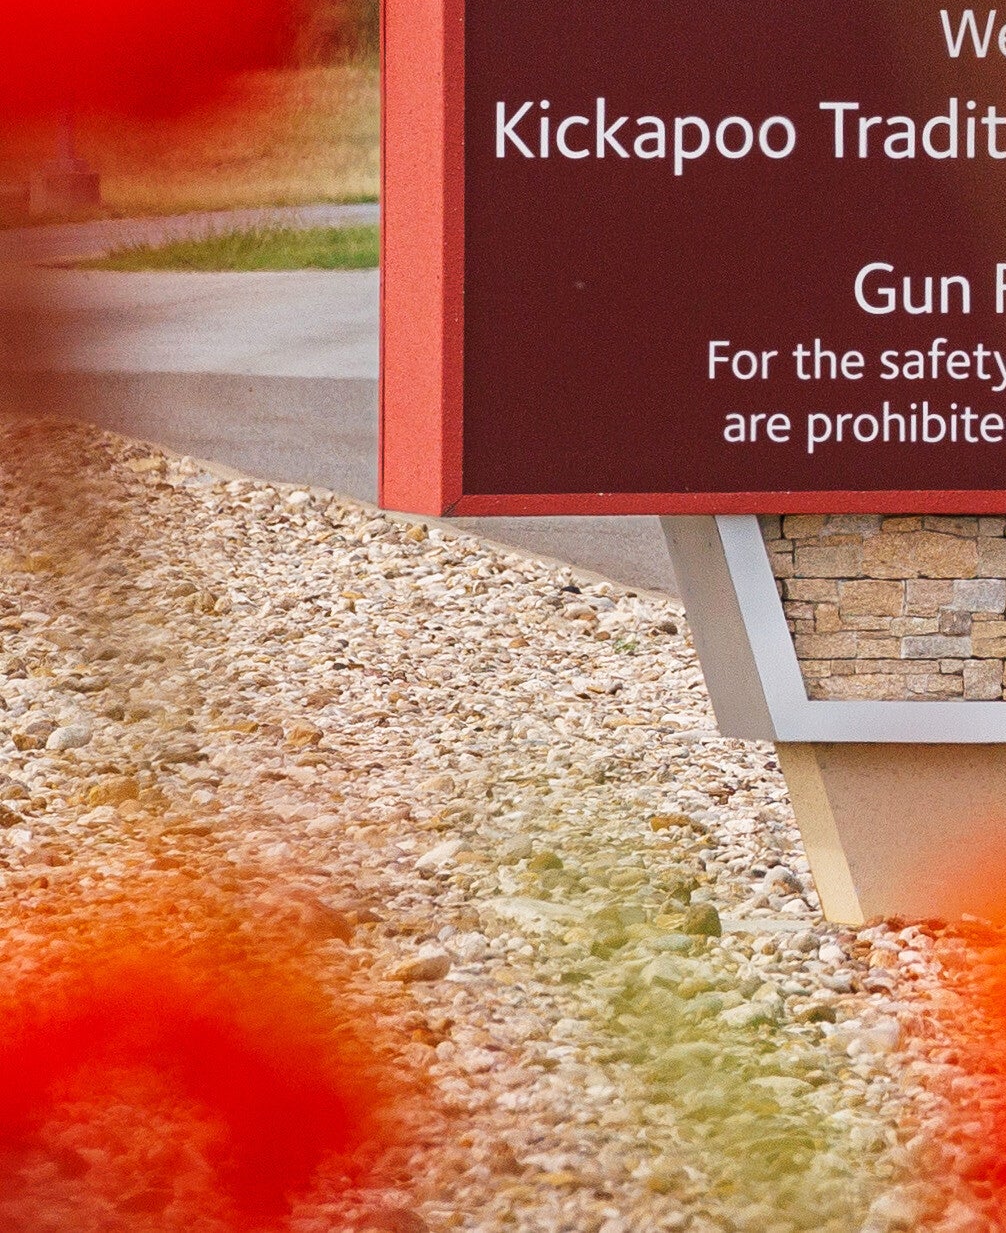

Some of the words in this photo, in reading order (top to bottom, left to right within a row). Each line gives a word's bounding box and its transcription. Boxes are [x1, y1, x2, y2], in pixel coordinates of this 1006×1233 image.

[495, 97, 797, 177] Kickapoo
[854, 262, 971, 315] Gun
[708, 340, 779, 380] For
[791, 338, 865, 381] the
[723, 412, 791, 443] are
